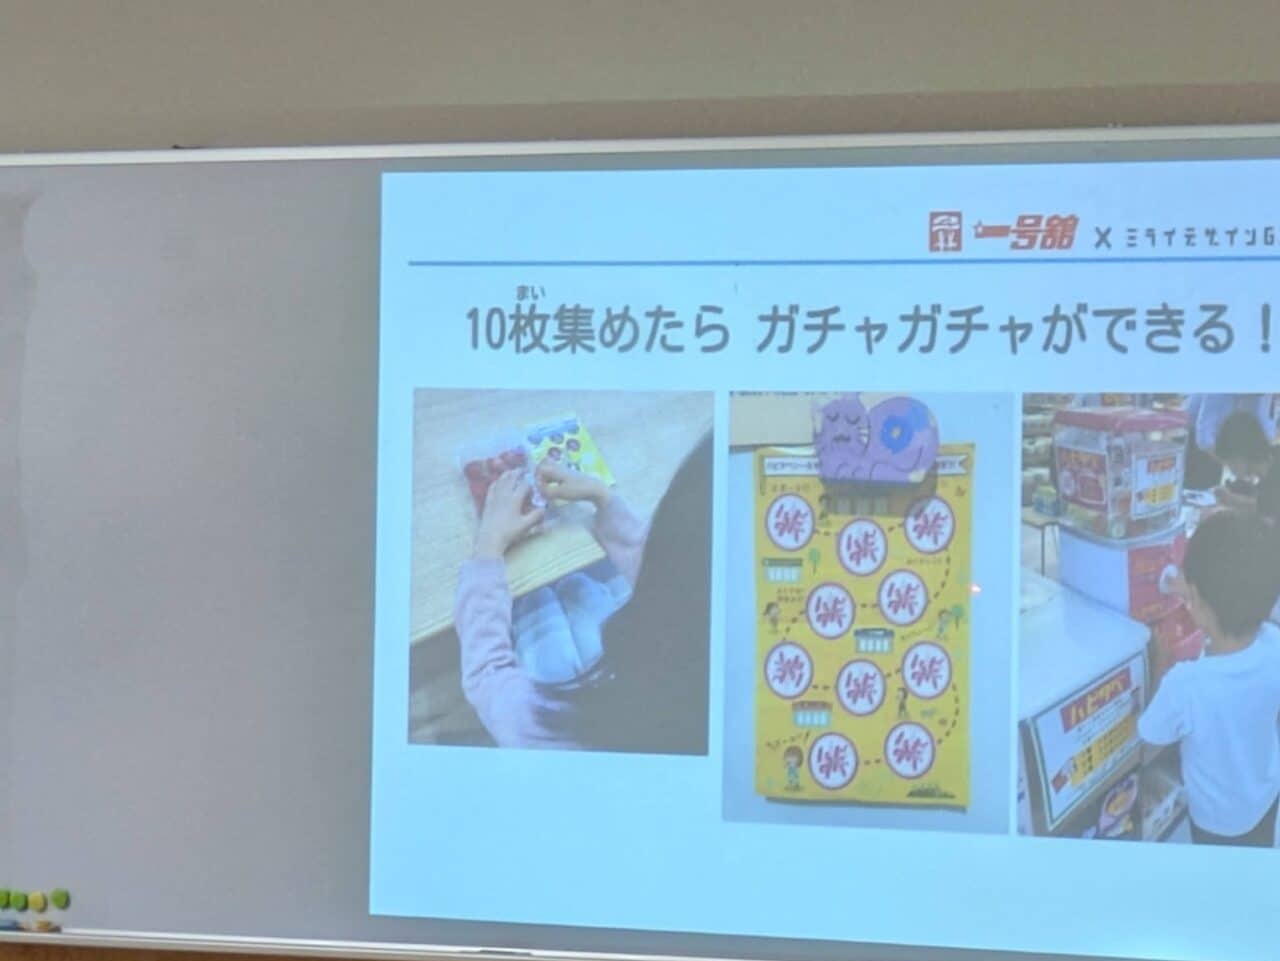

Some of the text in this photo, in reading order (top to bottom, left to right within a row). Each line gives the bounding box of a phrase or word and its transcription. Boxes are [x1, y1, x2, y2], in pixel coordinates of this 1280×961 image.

[516, 285, 546, 301] まい
[466, 303, 731, 355] 10枚集めたら
